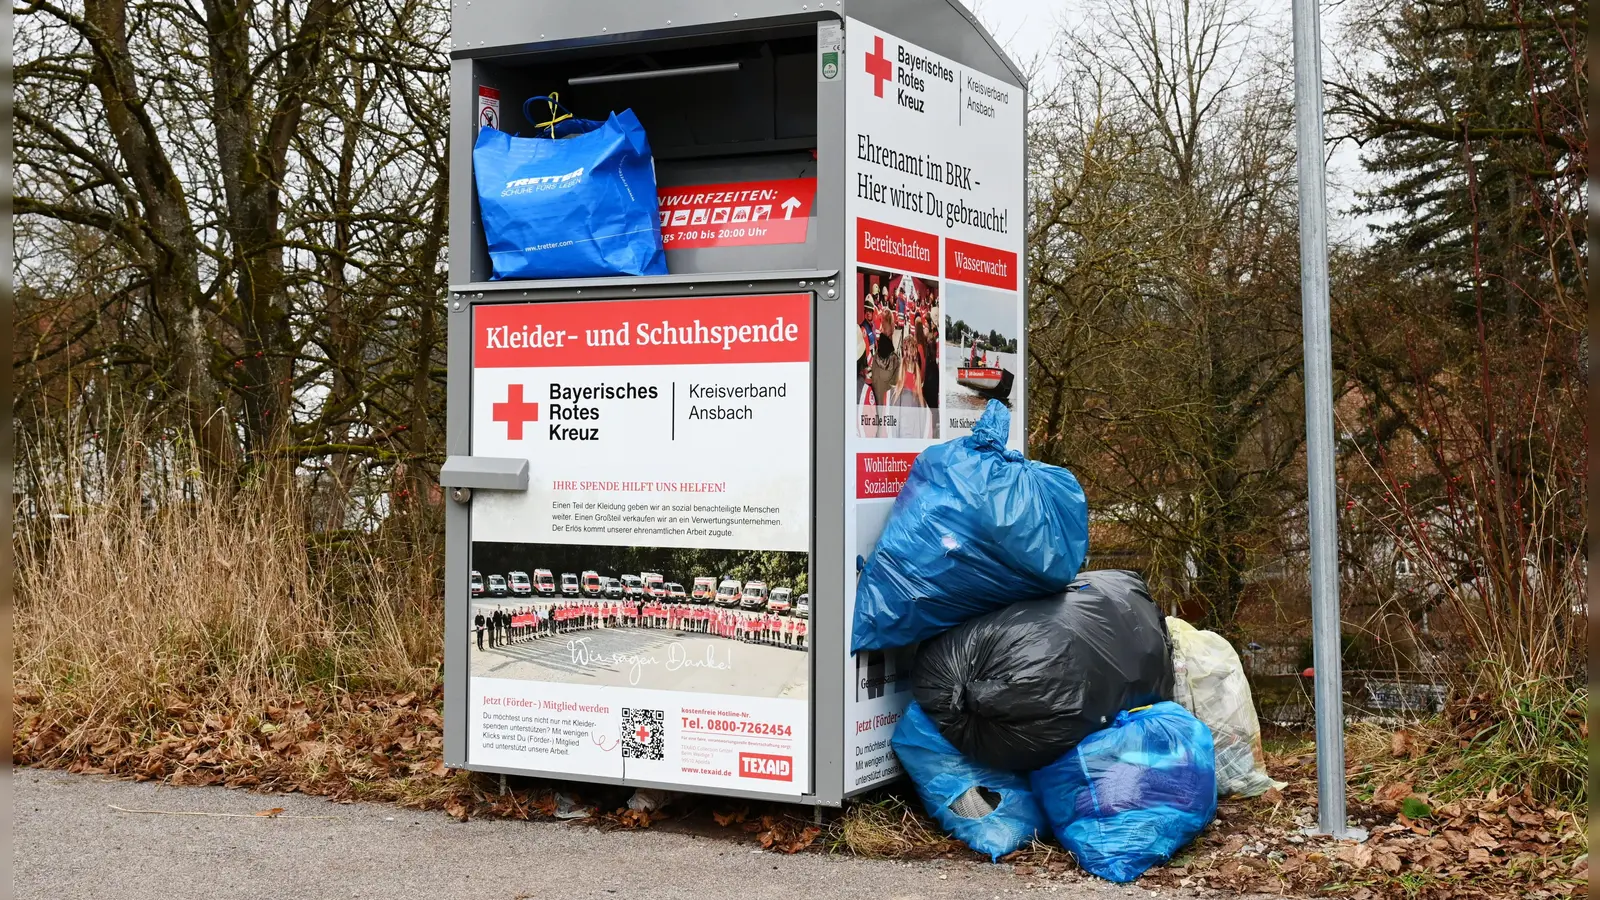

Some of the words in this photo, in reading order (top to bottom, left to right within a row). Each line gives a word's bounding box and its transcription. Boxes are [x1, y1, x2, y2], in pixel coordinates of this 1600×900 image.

[898, 46, 954, 82] Bayerisches
[898, 67, 925, 92] Rotes
[967, 76, 1008, 104] Kreisverband
[898, 88, 924, 113] Kreuz
[967, 98, 995, 118] Ansbach
[858, 134, 923, 177] Ehrenamt
[926, 155, 942, 182] im
[946, 162, 972, 190] BRK
[506, 167, 584, 188] TRETTER
[501, 187, 533, 197] SCHUHE
[536, 183, 556, 192] FÜRS
[559, 178, 581, 189] LEBEN
[658, 189, 778, 206] NWURFZEITEN:
[858, 173, 887, 203] Hier
[890, 184, 923, 213] wirst
[926, 192, 943, 218] Du
[946, 199, 1008, 234] gebraucht!
[678, 231, 698, 240] 7:00
[701, 230, 715, 239] bis
[718, 229, 744, 238] 20:00
[748, 228, 767, 236] Uhr
[525, 240, 573, 252] www.tretter.com
[864, 231, 930, 262] Bereitschaften
[954, 251, 1007, 277] Wasserwacht
[486, 325, 578, 349] Kleider-
[586, 322, 630, 346] und
[636, 317, 798, 350] Schuhspende
[550, 382, 658, 404] Bayerisches
[689, 382, 786, 398] Kreisverband
[550, 404, 600, 420] Rotes
[689, 405, 753, 420] Ansbach
[861, 415, 871, 425] Für
[872, 415, 882, 426] alle
[884, 415, 897, 426] Fälle
[950, 418, 958, 428] Mit
[550, 424, 599, 440] Kreuz
[864, 457, 911, 472] Wohlfahrts-
[553, 481, 578, 490] IHRE
[580, 481, 620, 491] SPENDE
[622, 482, 653, 491] HILFT
[656, 482, 677, 492] UNS
[680, 482, 726, 492] HELFEN!
[598, 503, 626, 511] Kleidung
[627, 503, 648, 512] geben
[694, 505, 741, 514] benachteiligte
[691, 516, 782, 526] Verwertungsunternehmen.
[634, 526, 685, 535] ehrenamtlichen
[708, 529, 734, 537] zugute.
[567, 637, 607, 666] Wir
[612, 654, 659, 686] sagen
[666, 642, 731, 672] Danke!
[483, 696, 501, 706] Jetzt
[503, 697, 542, 710] (Förder-)
[543, 701, 577, 712] Mitglied
[579, 703, 609, 714] werden
[493, 713, 520, 722] möchtest
[573, 719, 596, 727] Kleider-
[718, 710, 751, 718] Hotline-Nr.
[483, 722, 508, 731] spenden
[510, 724, 550, 734] unterstützen?
[563, 729, 588, 737] wenigen
[682, 717, 703, 729] Tel.
[708, 719, 792, 736] 0800-7262454
[856, 718, 872, 736] Jetzt
[496, 743, 526, 752] unterstützt
[527, 735, 554, 745] (Förder-)
[556, 738, 580, 746] Mitglied
[856, 745, 864, 756] Du
[864, 738, 887, 754] möchtest
[681, 766, 732, 776] www.texaid.de
[742, 757, 790, 776] TEXAID
[864, 755, 885, 770] wenigen
[856, 769, 881, 786] unterstützt
[882, 766, 899, 778] unsere
